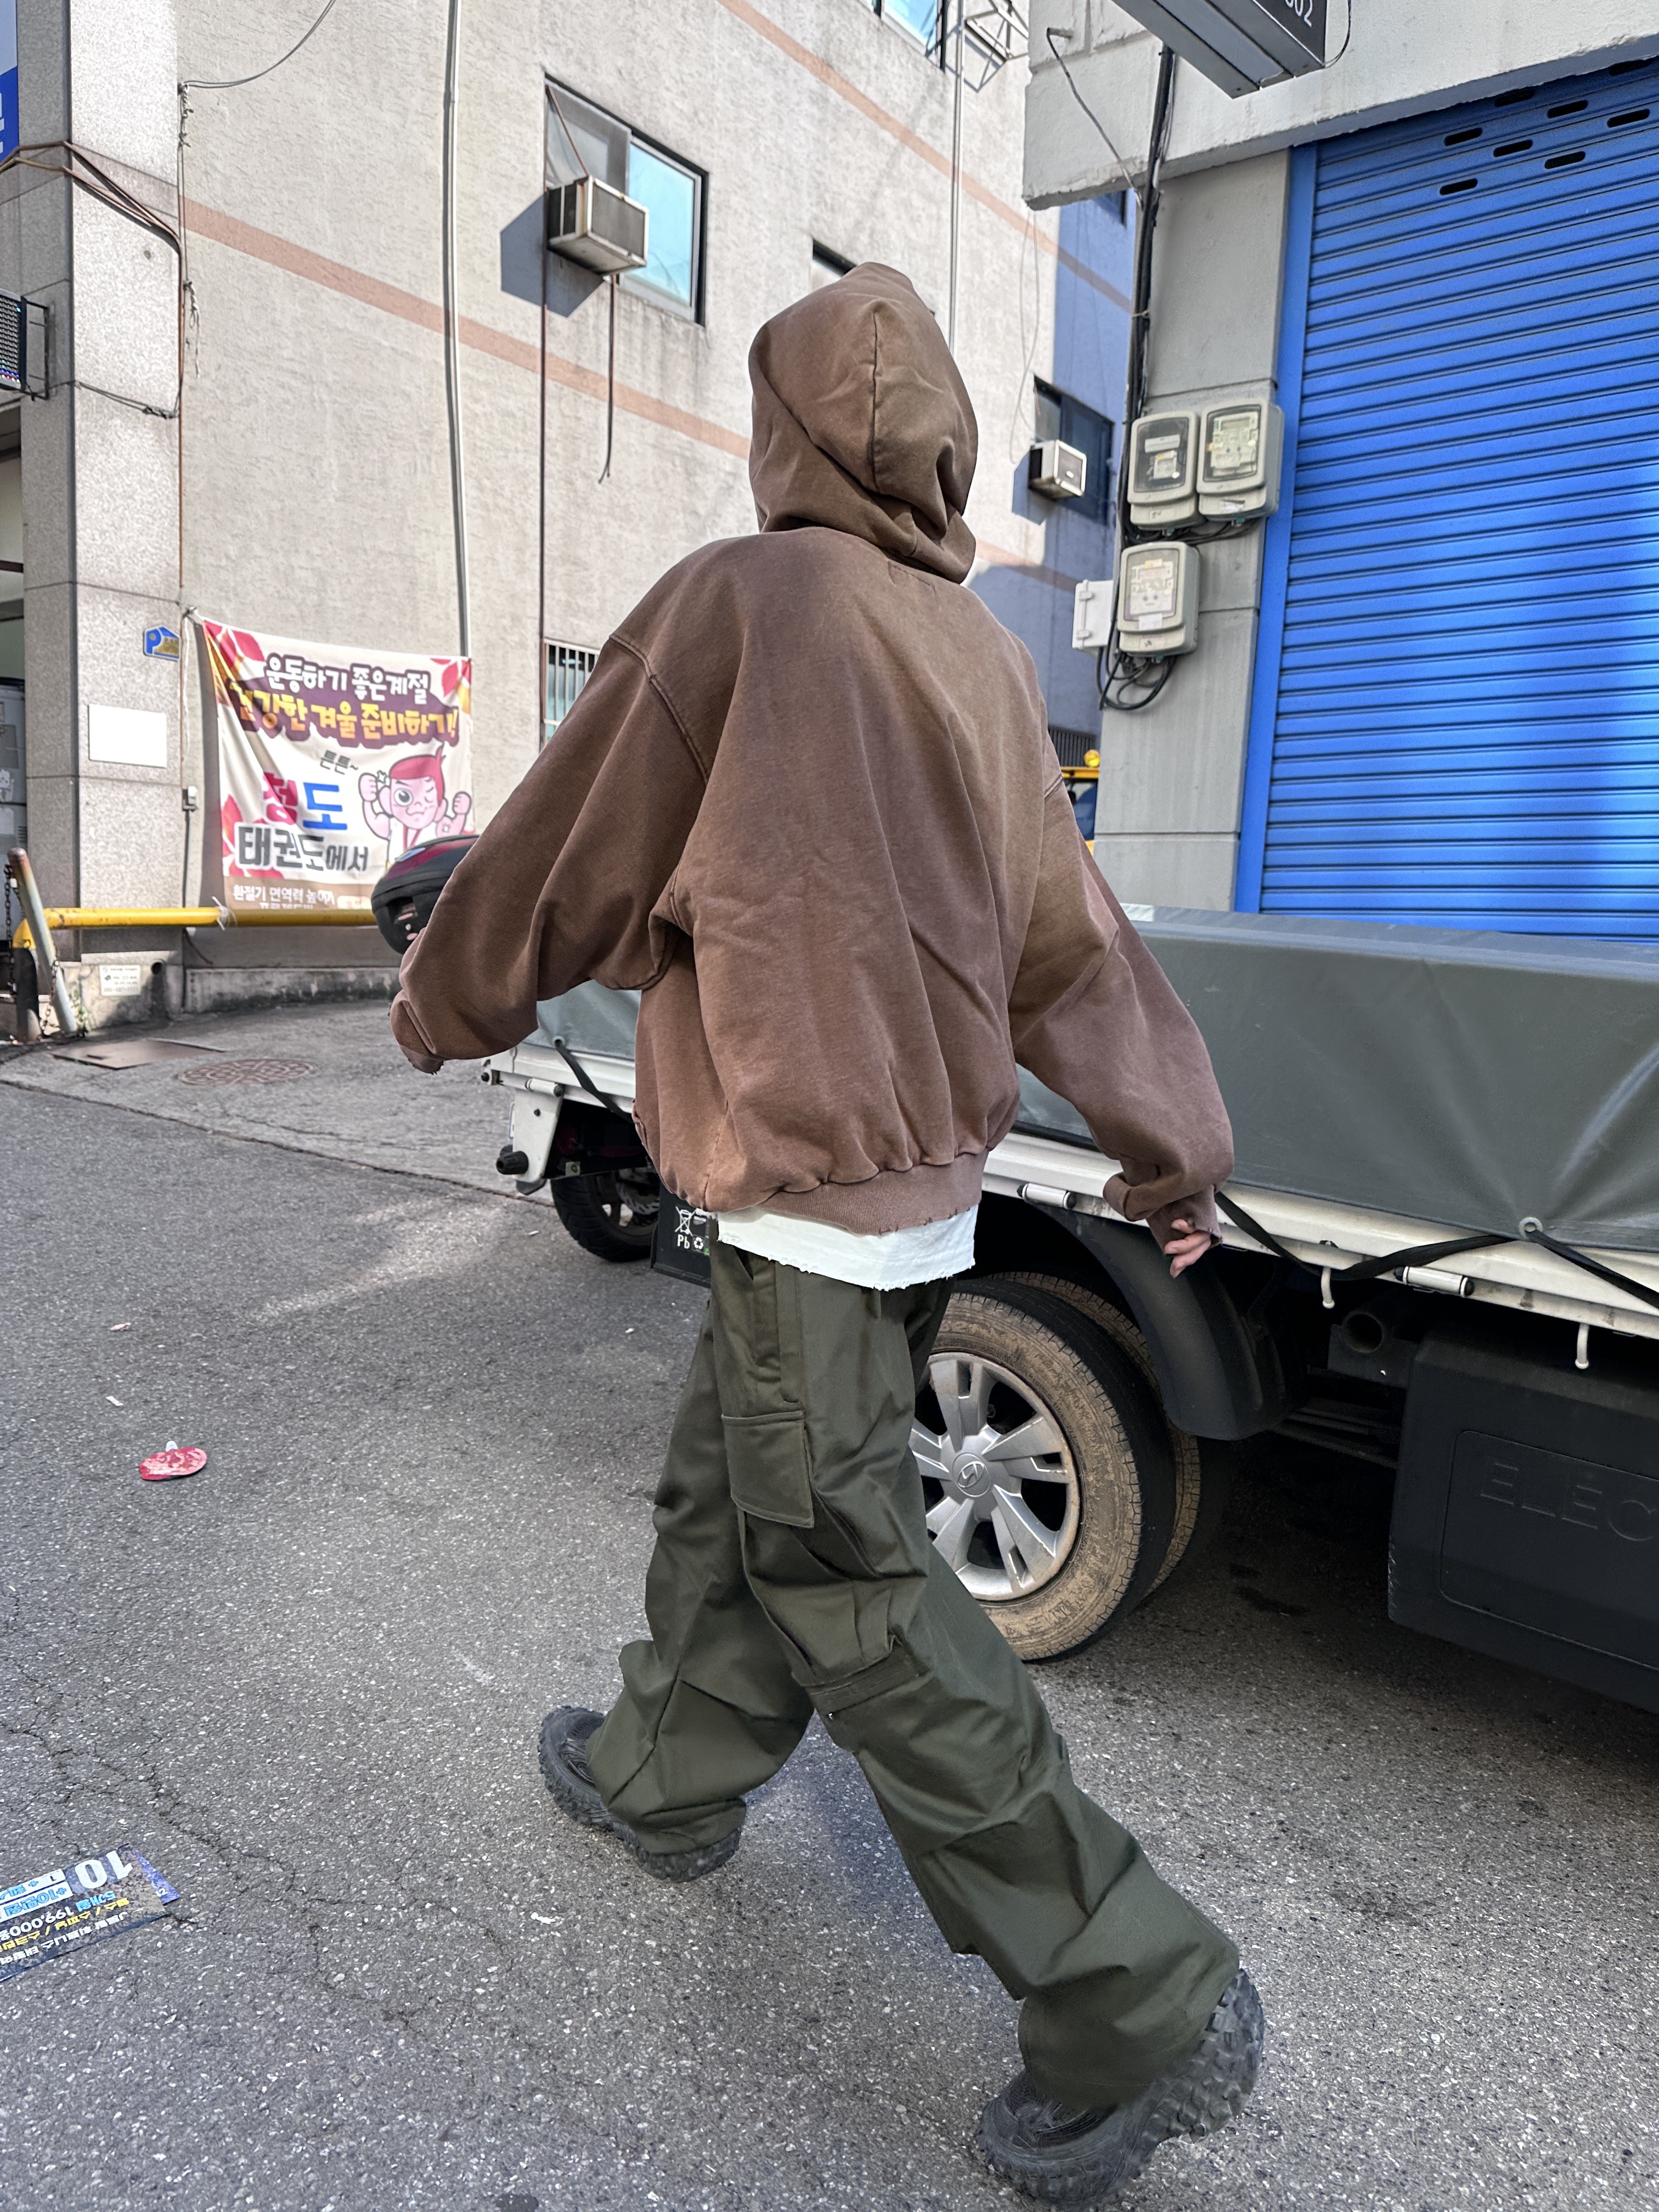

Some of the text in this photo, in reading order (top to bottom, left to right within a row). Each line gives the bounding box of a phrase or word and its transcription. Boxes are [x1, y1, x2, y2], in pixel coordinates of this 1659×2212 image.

[267, 656, 428, 705] 운동하기 좋은계절
[311, 701, 357, 739] 겨울
[360, 703, 458, 740] 준비하기!
[238, 825, 369, 872] 태권도에서
[233, 884, 266, 901] 환절기
[269, 886, 303, 904] 면역력
[677, 1234, 690, 1249] Pb
[75, 1850, 133, 1888] 10
[76, 1891, 116, 1912] 5개월
[0, 1931, 40, 1953] 스크린
